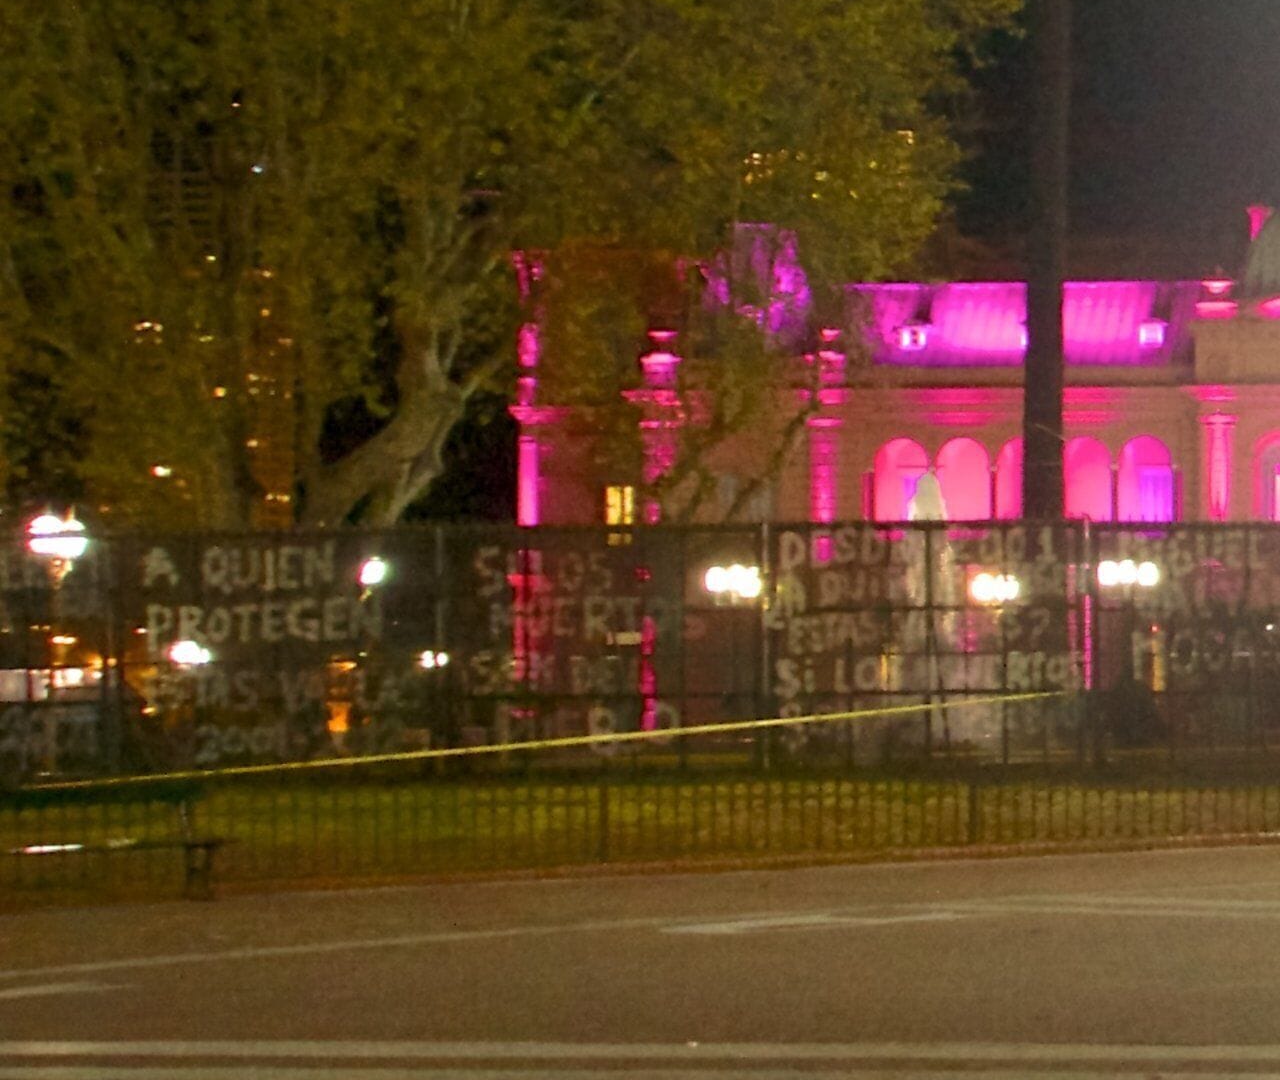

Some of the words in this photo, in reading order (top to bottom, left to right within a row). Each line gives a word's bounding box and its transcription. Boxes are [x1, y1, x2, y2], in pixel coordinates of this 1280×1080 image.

[143, 546, 180, 587] A
[201, 542, 337, 594] QUIEN
[145, 596, 383, 652] PROTEGEN
